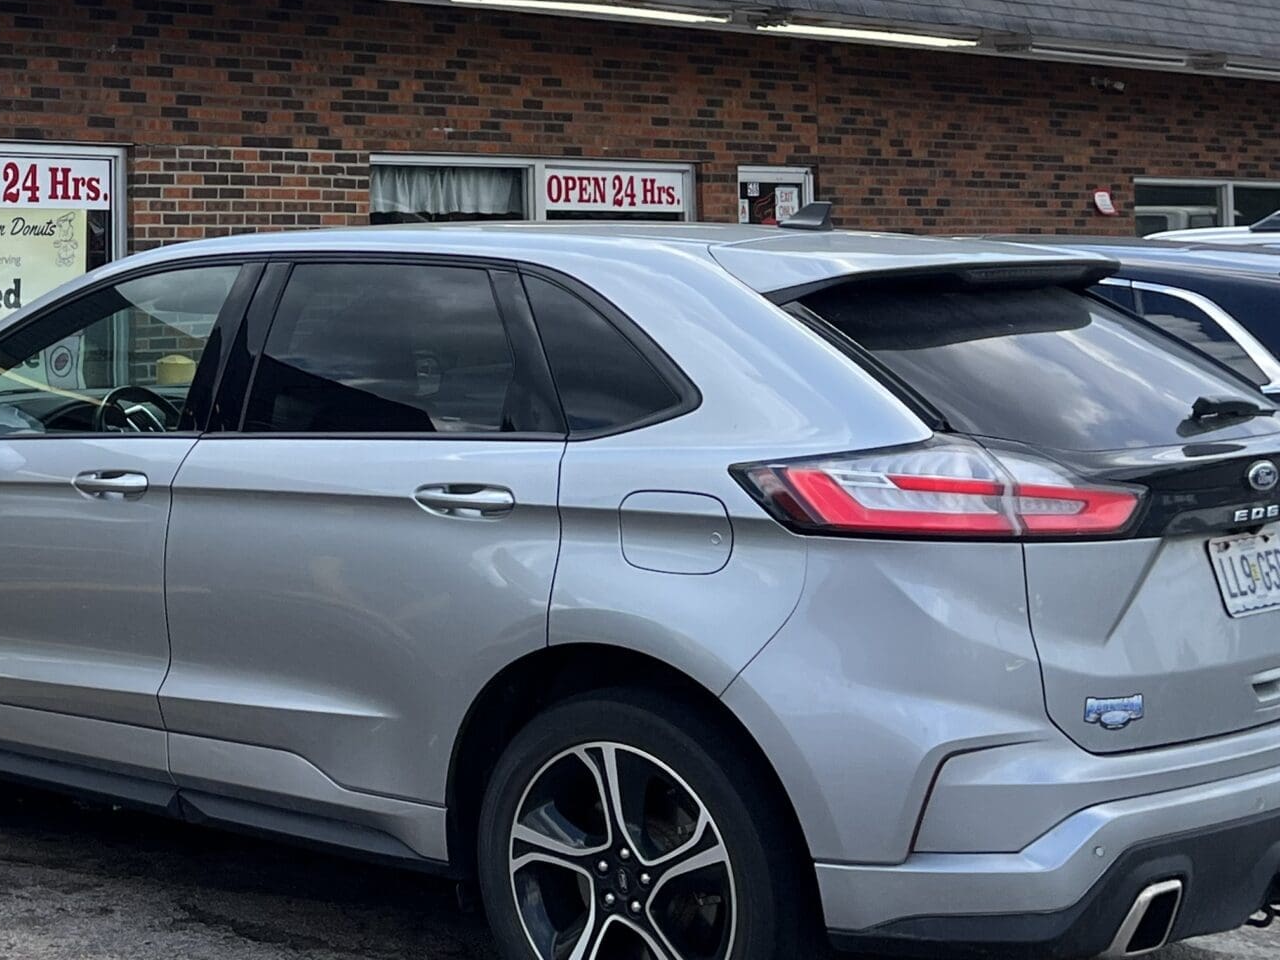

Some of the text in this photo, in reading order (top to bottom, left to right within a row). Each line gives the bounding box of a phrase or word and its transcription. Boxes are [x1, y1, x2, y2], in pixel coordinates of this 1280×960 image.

[2, 161, 40, 204] 24
[47, 167, 109, 202] Hrs.
[546, 174, 681, 207] OPEN 24 Hrs.
[780, 191, 793, 202] EXIT
[10, 216, 57, 237] Donuts
[1218, 554, 1257, 598] LL9
